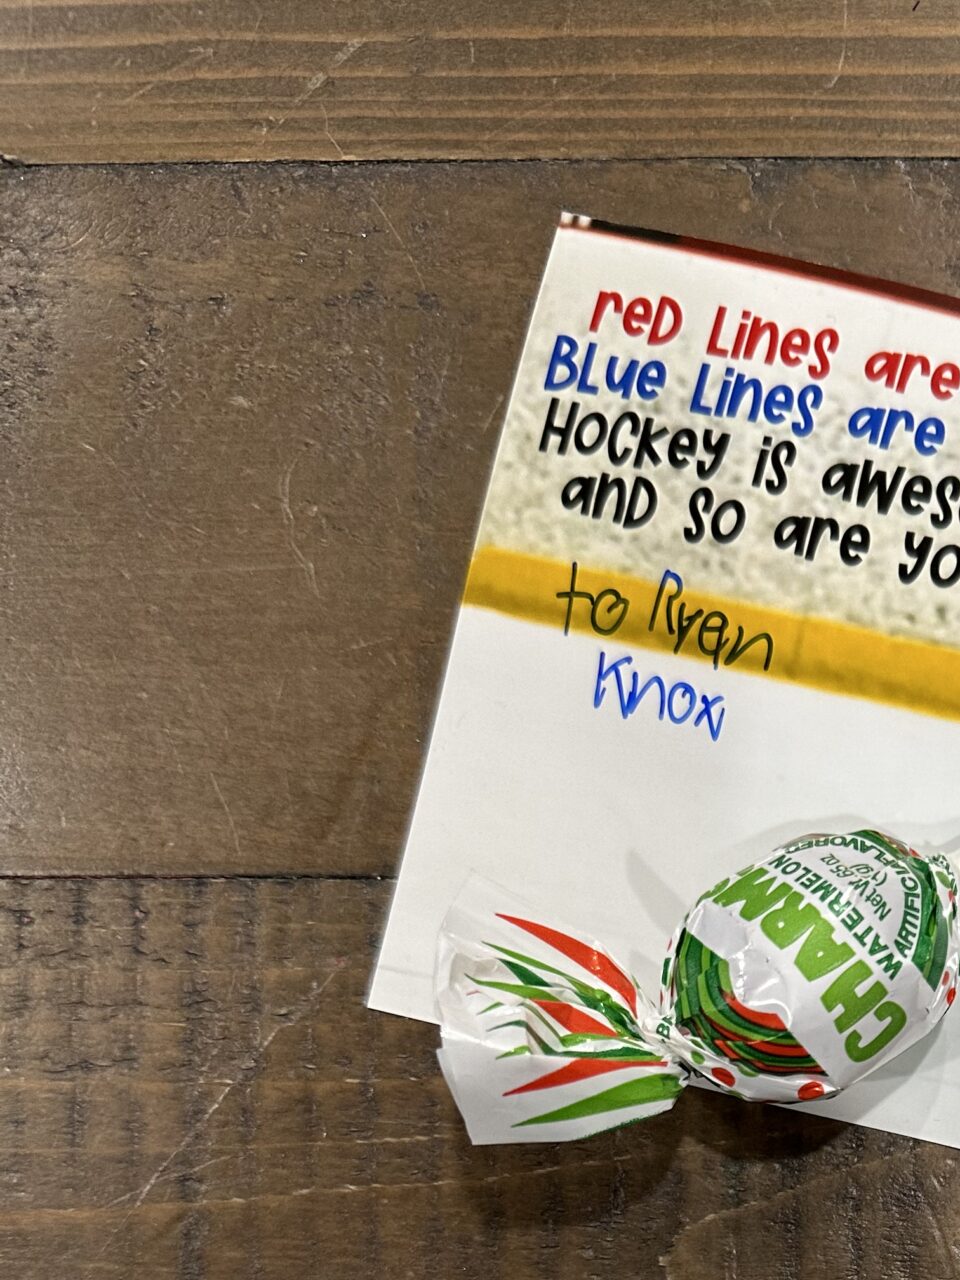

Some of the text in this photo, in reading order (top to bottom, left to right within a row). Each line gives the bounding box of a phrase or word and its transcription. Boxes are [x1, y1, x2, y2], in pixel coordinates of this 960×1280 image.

[751, 435, 798, 496] is
[848, 406, 946, 457] are
[683, 486, 747, 544] so
[774, 515, 871, 567] are
[556, 561, 774, 671] to Ryan
[593, 650, 726, 742] Knox
[768, 854, 904, 980] WATERMELON
[864, 887, 892, 922] Net
